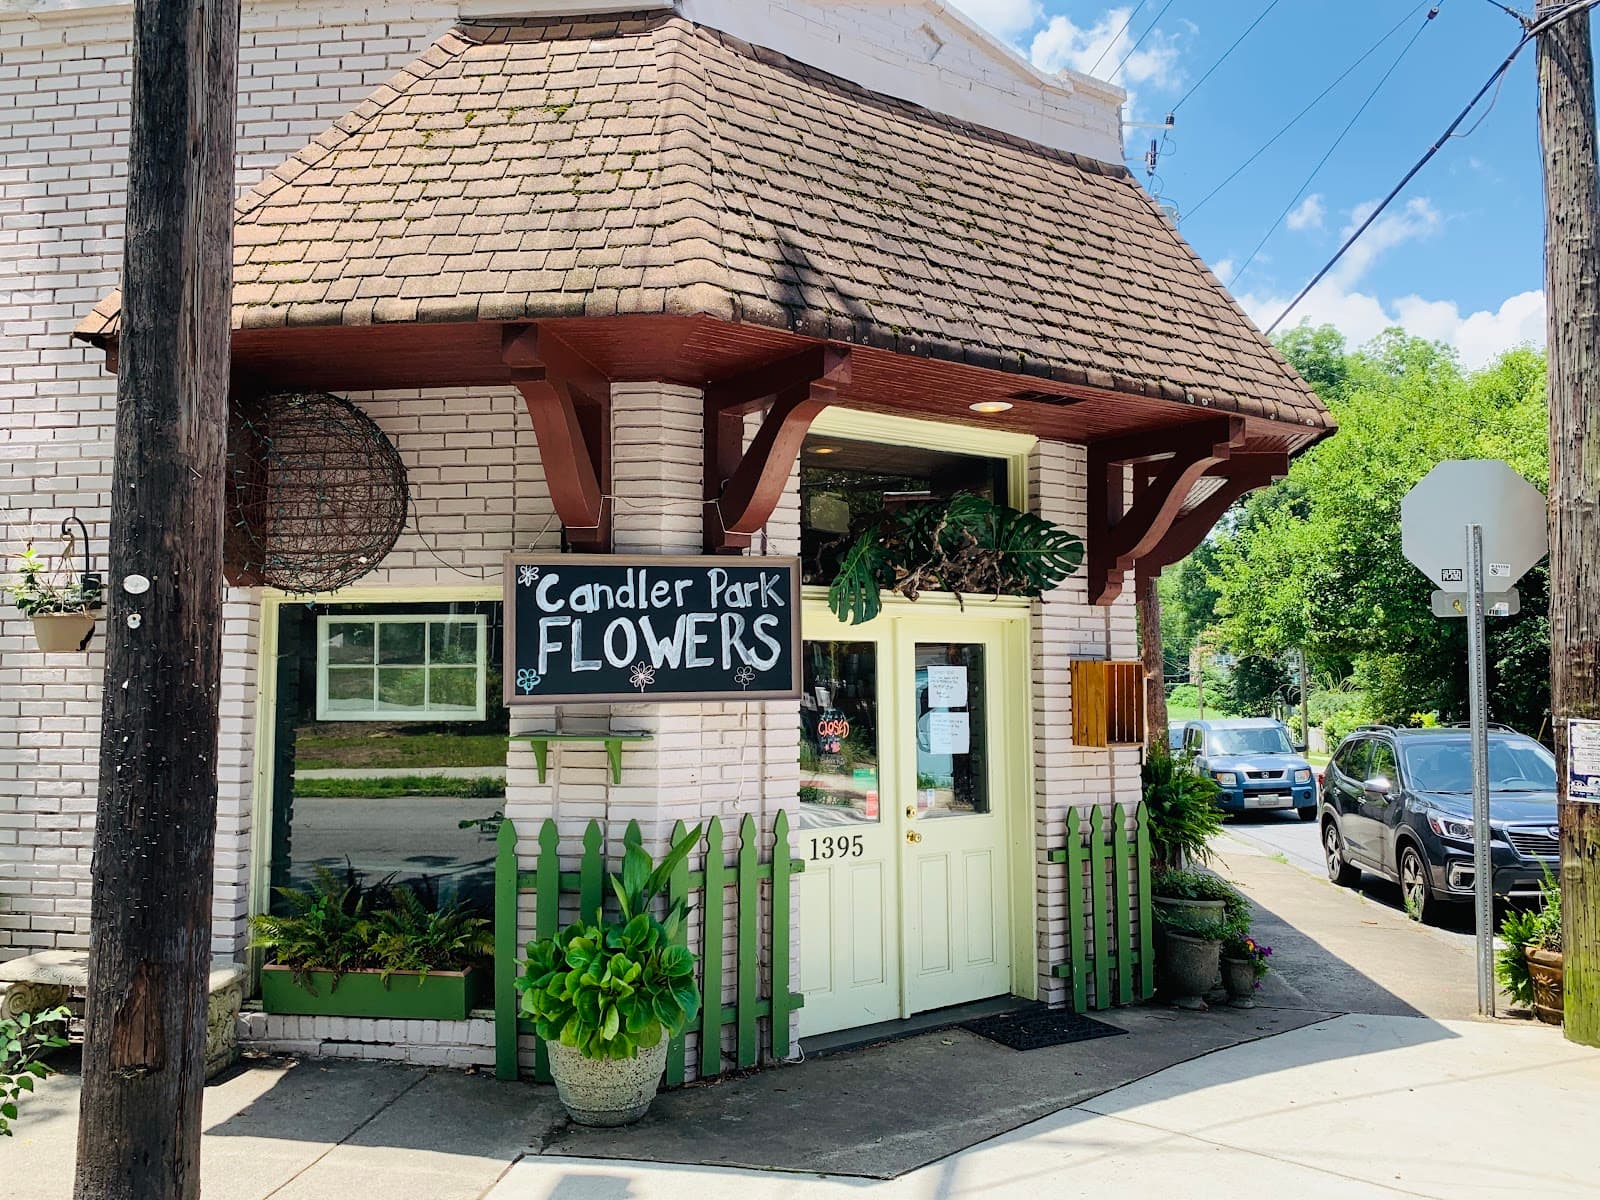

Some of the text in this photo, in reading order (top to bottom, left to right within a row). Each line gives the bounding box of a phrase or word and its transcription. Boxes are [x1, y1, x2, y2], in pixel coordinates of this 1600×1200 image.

[535, 568, 785, 613] Candler Park
[538, 612, 782, 675] FLOWERS
[809, 835, 864, 861] 1395
